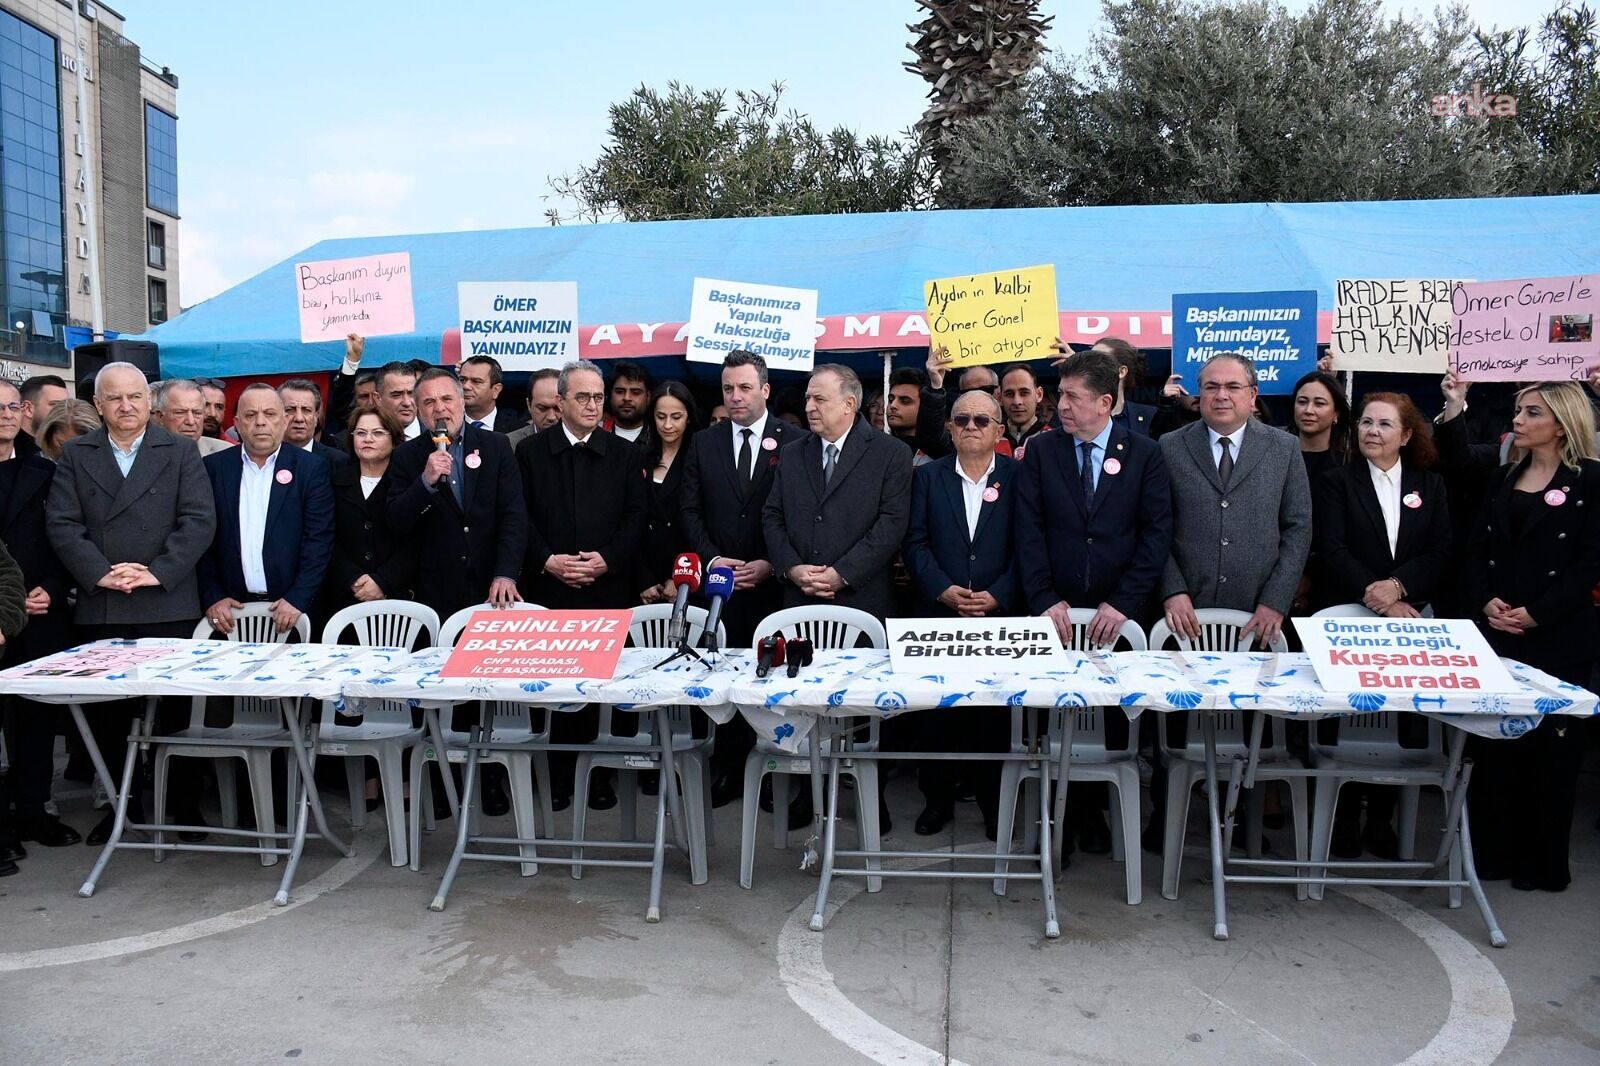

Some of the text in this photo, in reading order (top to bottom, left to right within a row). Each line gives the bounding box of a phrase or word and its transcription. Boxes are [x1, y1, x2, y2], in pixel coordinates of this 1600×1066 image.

[62, 53, 94, 82] HOEL
[375, 261, 406, 281] duyun
[494, 295, 537, 311] ÖMER
[708, 290, 801, 310] Başkanımıza
[1451, 282, 1514, 316] Ömer
[729, 308, 782, 324] Yapılan
[934, 306, 1024, 333] Ömer Günel
[1186, 307, 1300, 326] Başkanımızın
[1336, 303, 1434, 329] HALKIN
[463, 320, 572, 337] BAŞKANIMIZIN
[714, 322, 791, 343] Haksızlığa
[1195, 326, 1290, 345] Yanındayız,
[1450, 312, 1541, 347] destek ol
[693, 336, 741, 351] Sessiz
[959, 339, 982, 358] bir
[993, 337, 1042, 357] atıyor
[1331, 322, 1453, 355] TA KENDİSİ
[471, 342, 566, 355] YANINDAYIZ !
[744, 341, 811, 360] Kalmayız
[1536, 352, 1585, 370] sahip
[469, 617, 620, 633] SENİNLEYİZ
[1323, 620, 1450, 634] Ömer Günel
[897, 627, 1048, 645] Adalet İçin
[1326, 636, 1461, 650] Yalnız Değil,
[462, 638, 616, 654] BAŞKANIM !
[904, 645, 1053, 659] Birlikteyiz
[482, 657, 578, 666] CHP KUŞADASI
[1329, 650, 1478, 671] Kuşadası
[470, 665, 584, 675] İLÇE BAŞKANLIĞI
[1358, 671, 1481, 689] Burada
